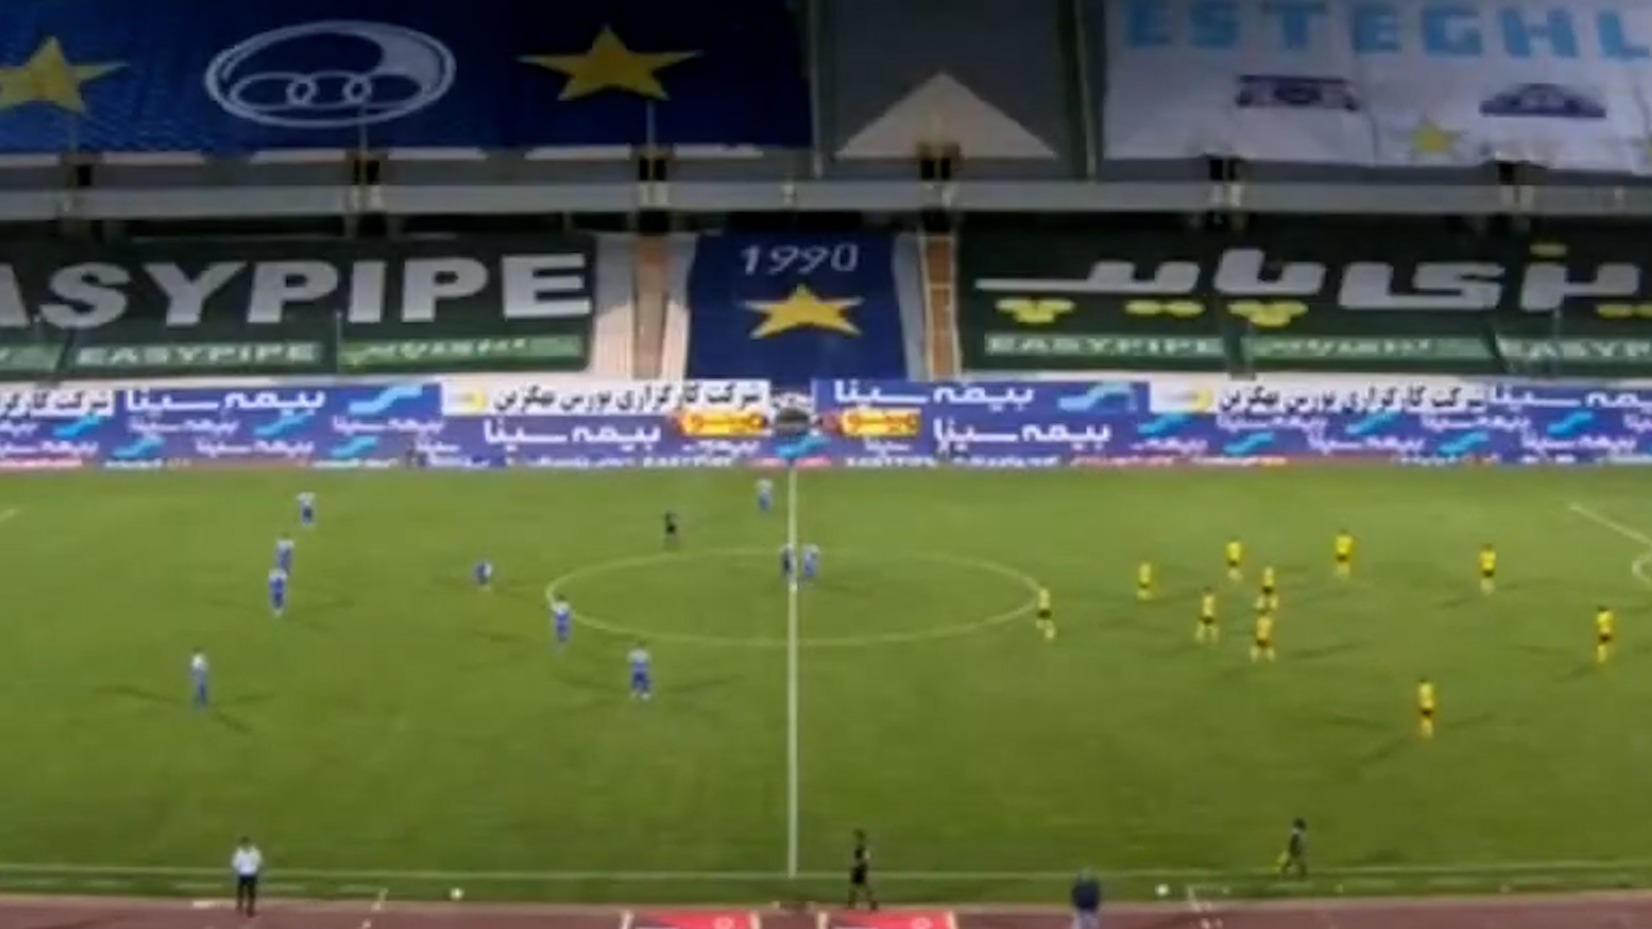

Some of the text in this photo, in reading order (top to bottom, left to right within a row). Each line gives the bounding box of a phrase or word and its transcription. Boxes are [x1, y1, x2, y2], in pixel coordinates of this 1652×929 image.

[740, 243, 859, 275] 1990
[975, 248, 1328, 328] پایپ
[77, 342, 319, 367] EASYPIPE
[985, 334, 1224, 356] EASYPIPE
[126, 388, 326, 416] بیمه سینا
[617, 384, 699, 412] کارگزاری
[707, 382, 760, 411] شرکت
[834, 379, 930, 410] سینا
[933, 386, 1035, 412] بیمه
[1492, 383, 1581, 412] سینا
[483, 417, 662, 451] بیمه سینا
[933, 418, 1018, 451] سینا
[1022, 423, 1112, 451] بیمه
